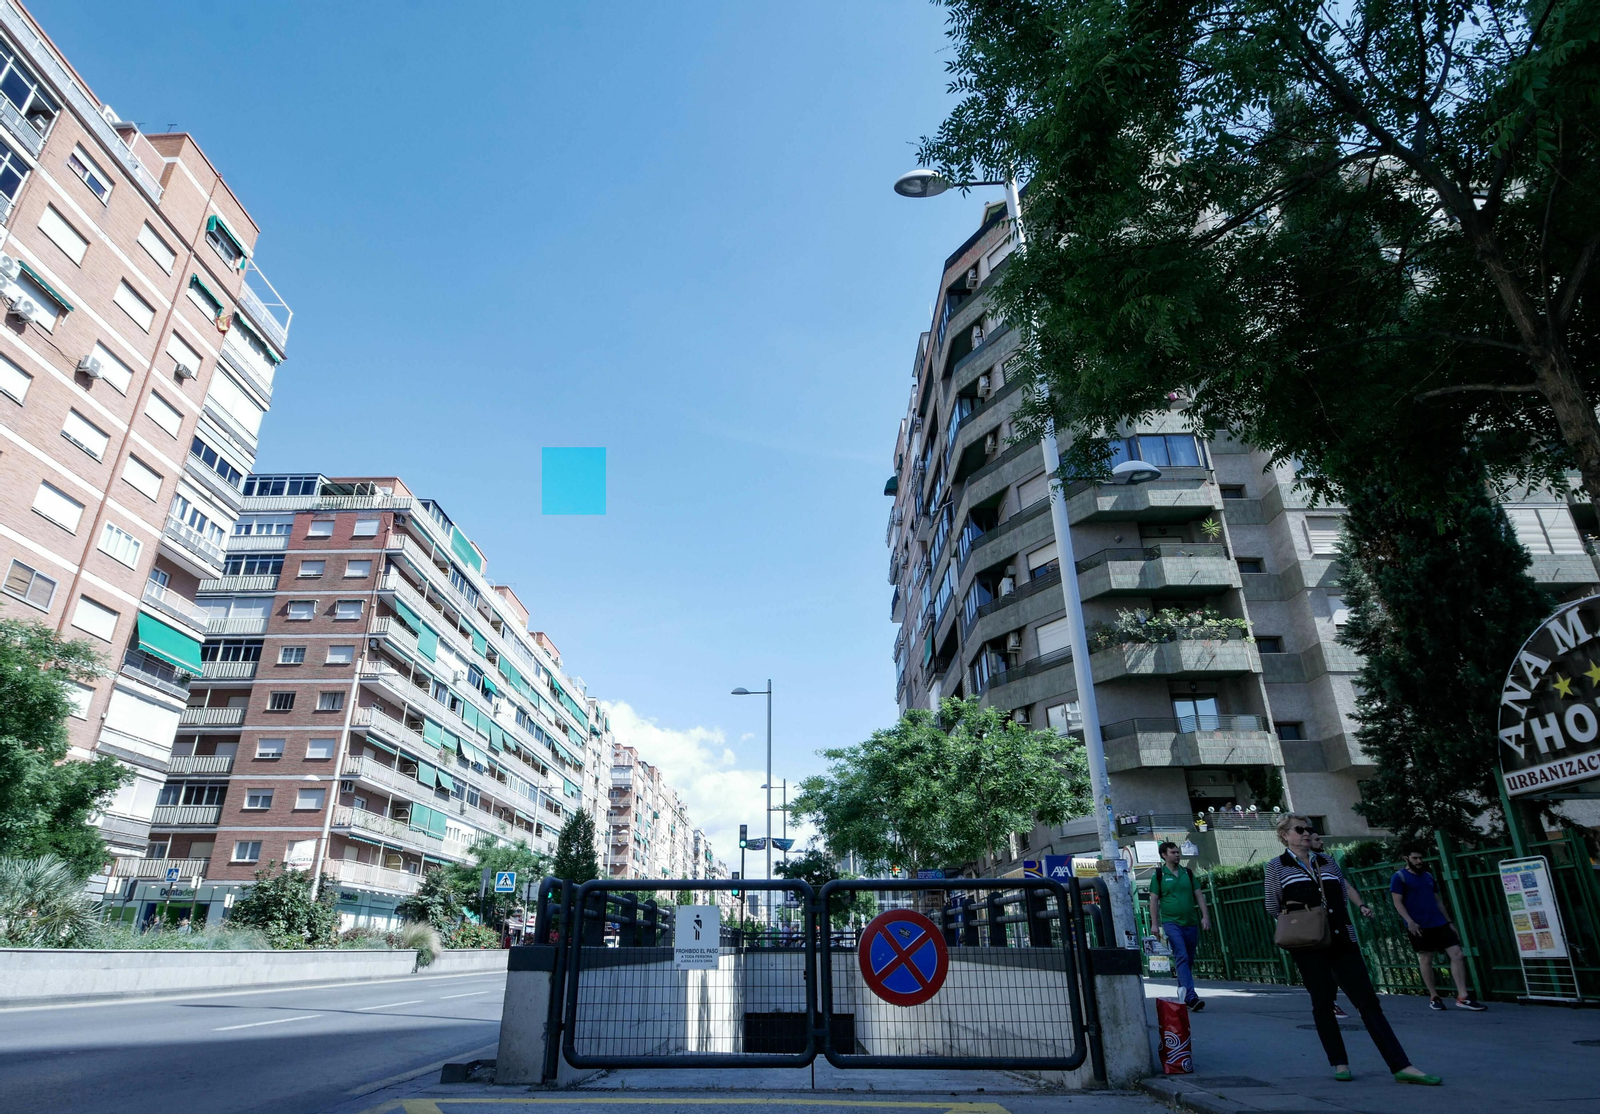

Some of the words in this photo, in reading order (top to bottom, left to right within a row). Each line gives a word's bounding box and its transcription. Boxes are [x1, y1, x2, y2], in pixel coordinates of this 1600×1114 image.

[1499, 650, 1552, 759] ANA
[1546, 606, 1600, 656] M
[1529, 697, 1600, 754] HO
[1050, 866, 1071, 877] AXA
